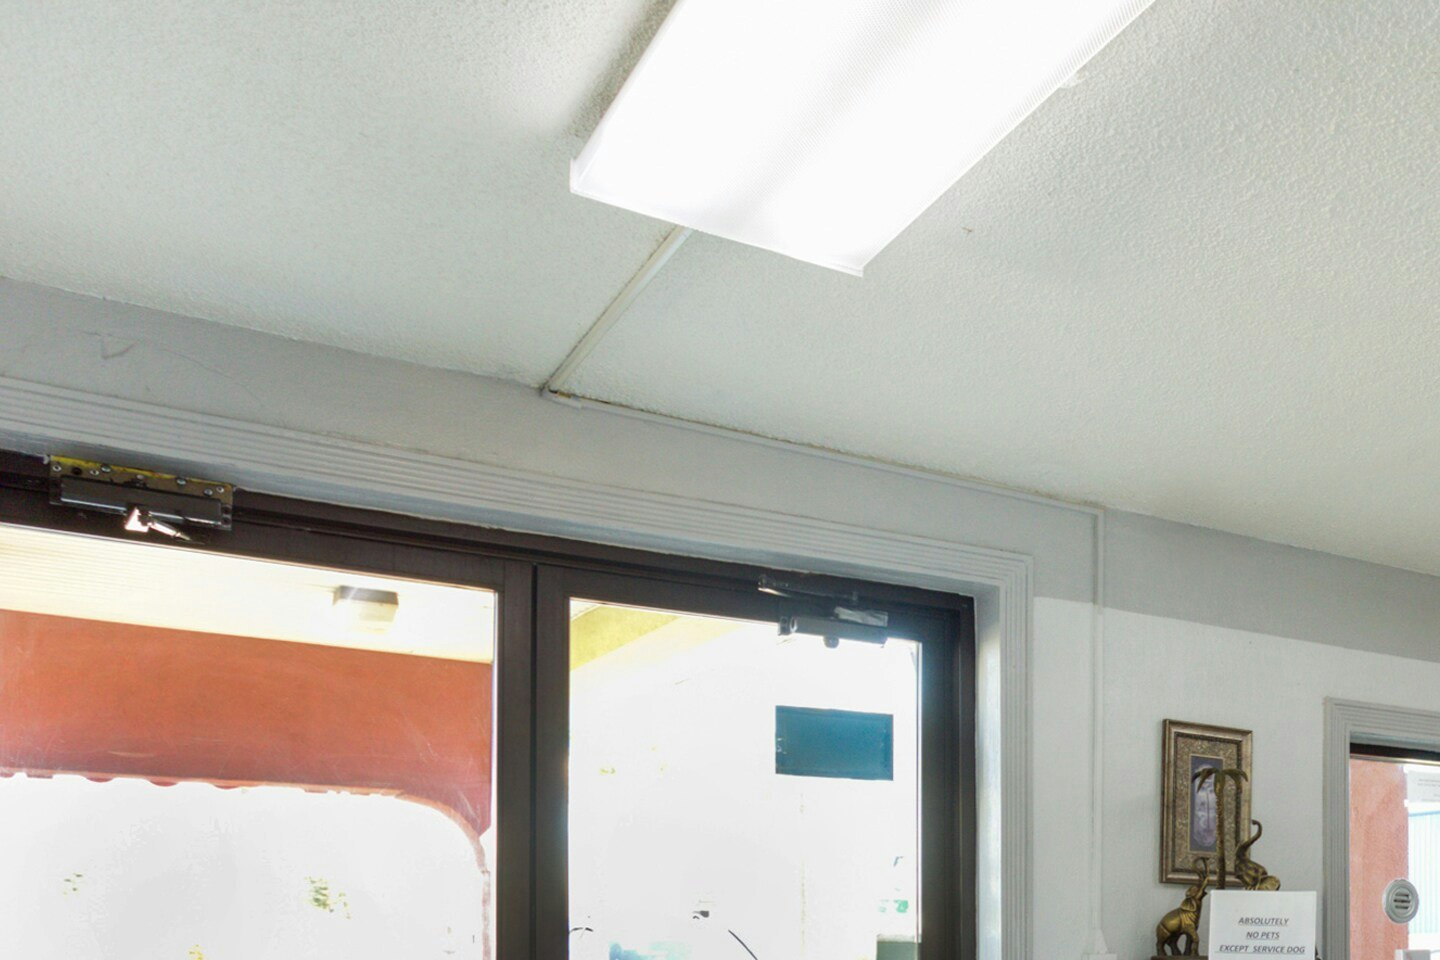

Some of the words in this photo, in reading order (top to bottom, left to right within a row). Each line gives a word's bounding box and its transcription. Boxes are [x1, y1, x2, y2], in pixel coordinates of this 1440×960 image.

[1238, 917, 1289, 926] ABSOLUTELY
[1246, 931, 1259, 939] NO
[1260, 931, 1280, 939] PETS
[1219, 944, 1249, 953] EXCEPT
[1253, 945, 1286, 954] SERVICE
[1286, 946, 1305, 954] DOG
